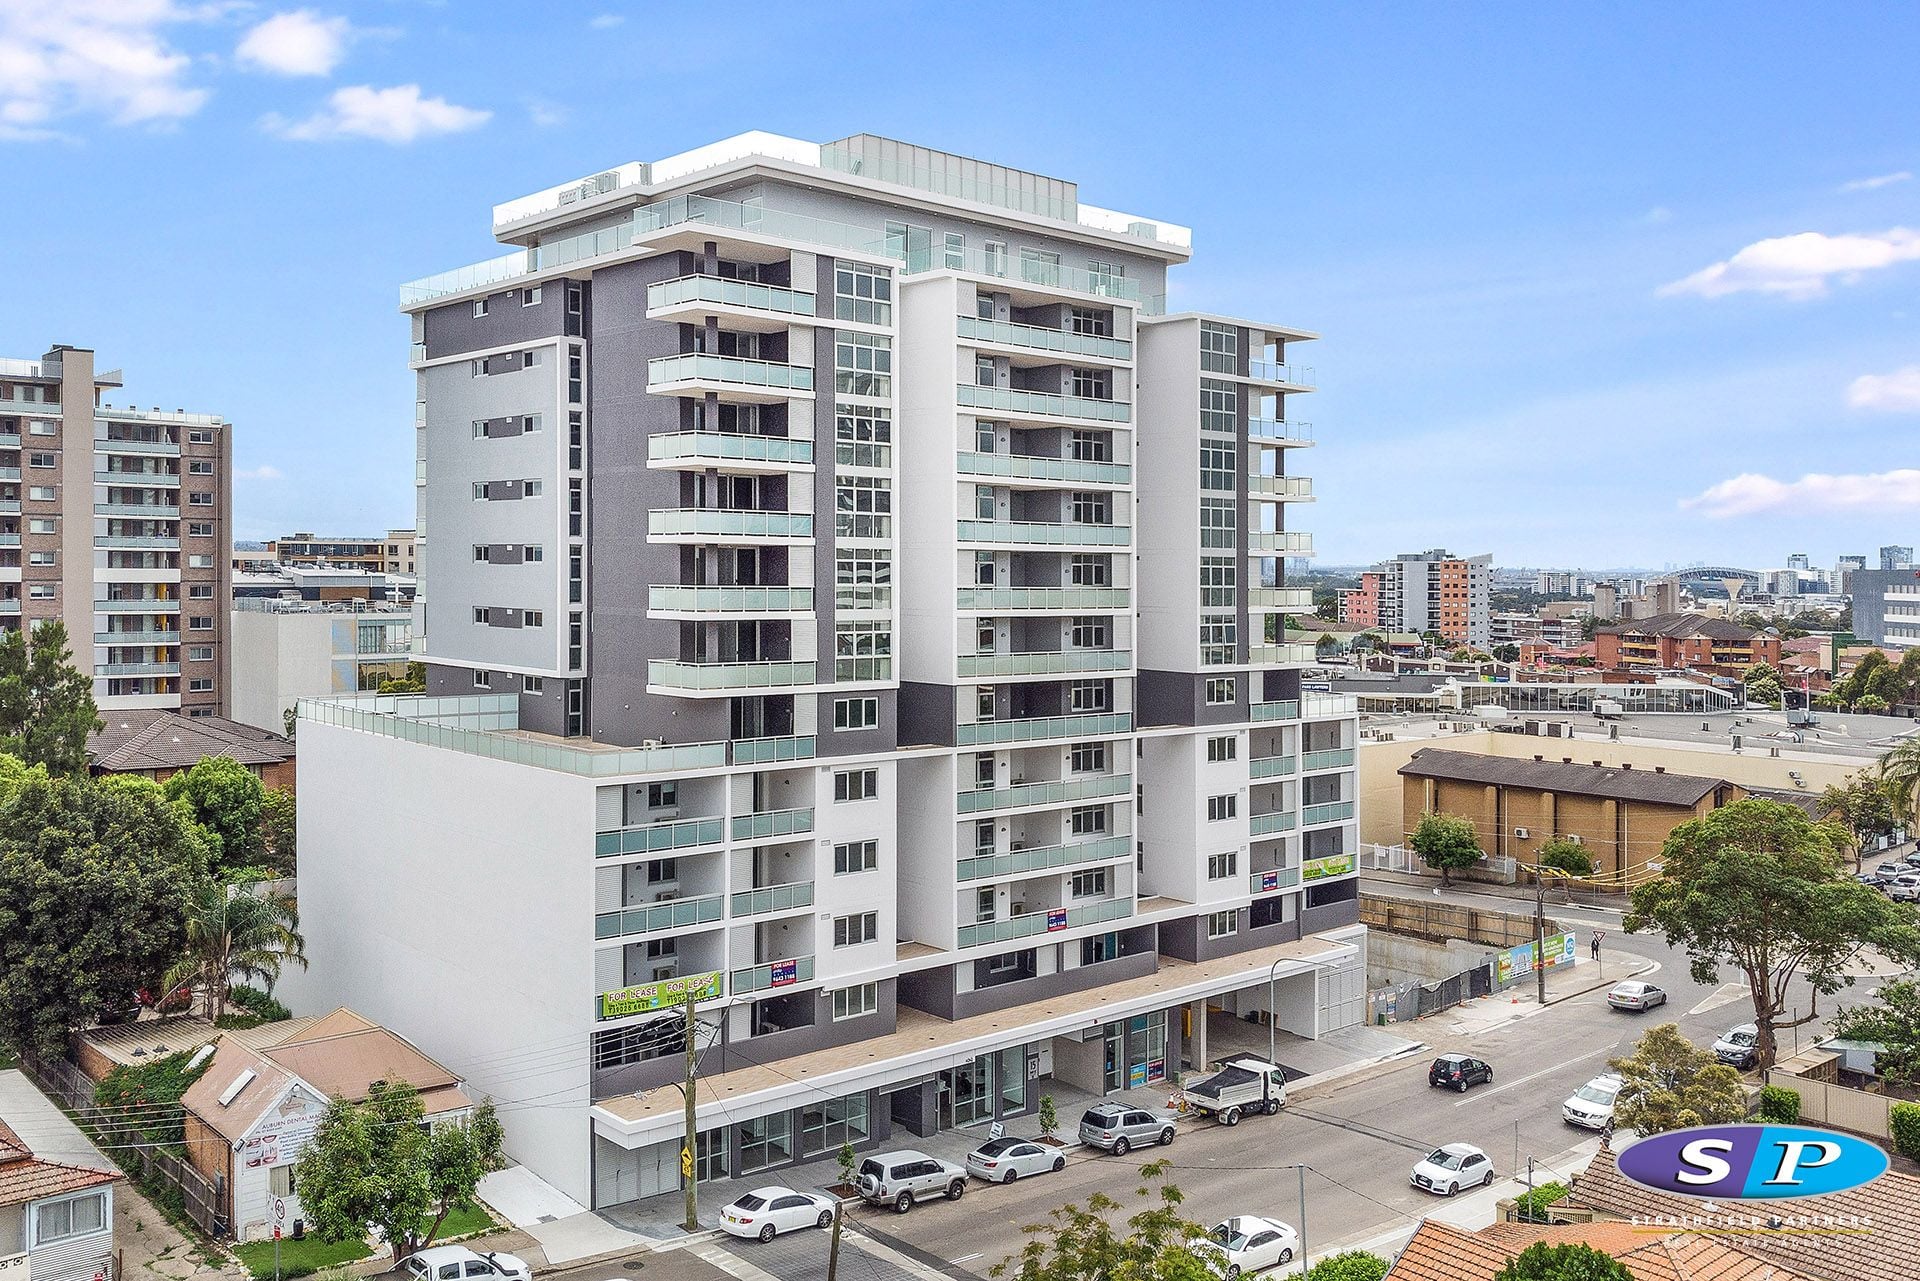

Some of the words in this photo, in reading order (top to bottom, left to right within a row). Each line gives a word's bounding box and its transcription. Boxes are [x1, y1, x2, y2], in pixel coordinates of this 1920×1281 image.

[666, 981, 685, 994] FOR
[688, 976, 714, 989] LEASE
[607, 991, 627, 1003] FOR
[630, 986, 658, 1000] LEASE
[262, 1119, 286, 1130] AUBURN
[286, 1116, 309, 1125] DENTAL
